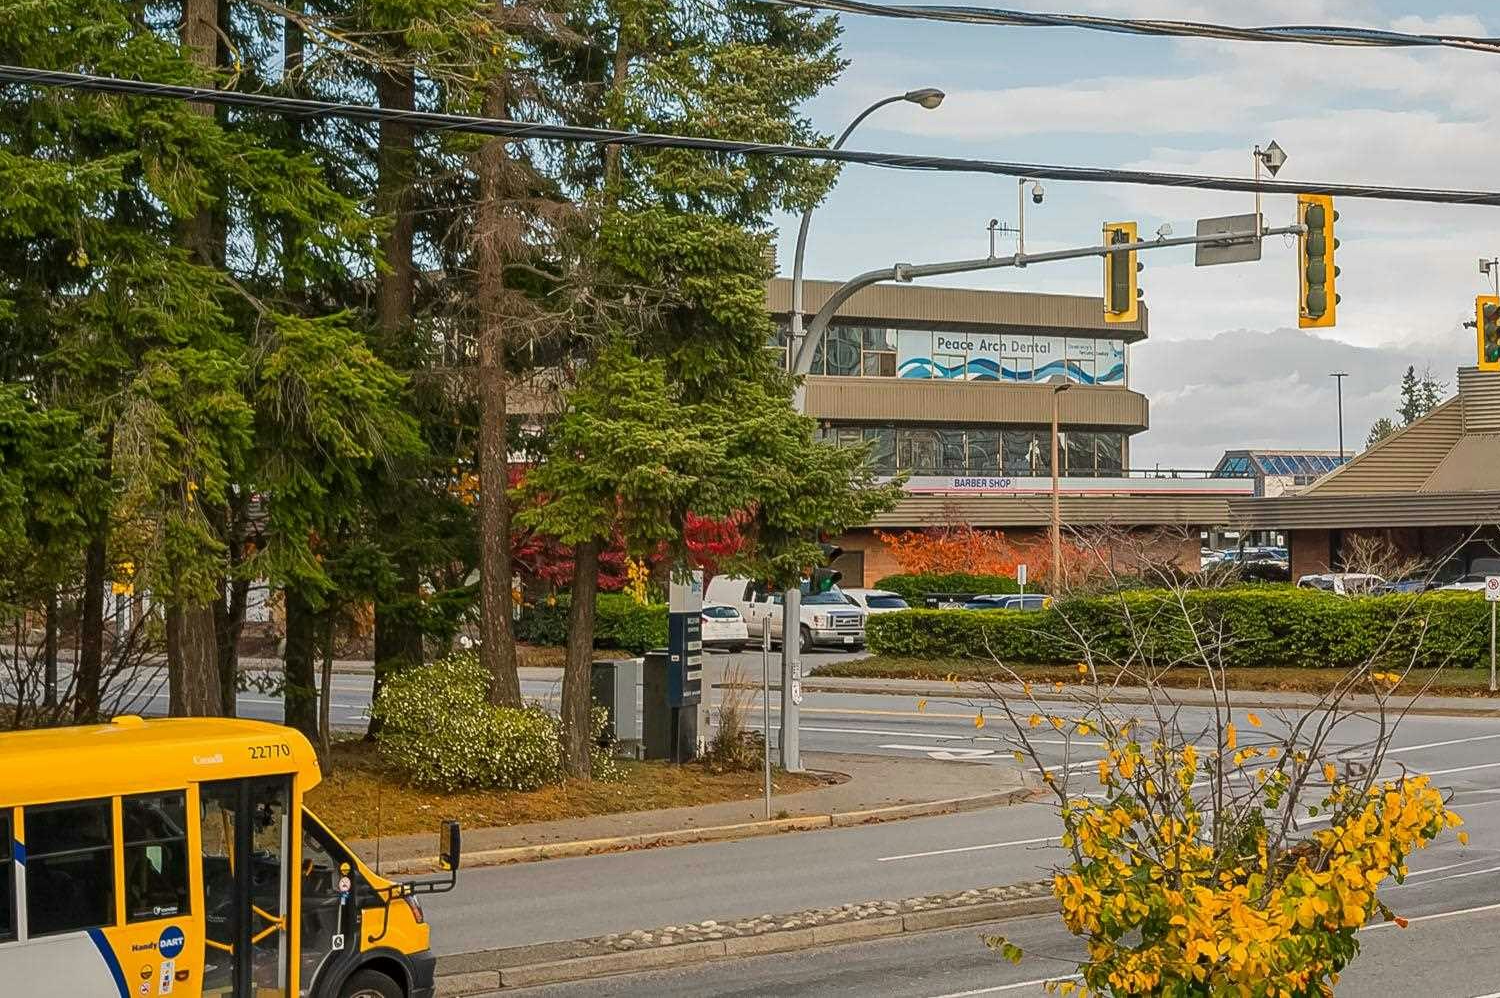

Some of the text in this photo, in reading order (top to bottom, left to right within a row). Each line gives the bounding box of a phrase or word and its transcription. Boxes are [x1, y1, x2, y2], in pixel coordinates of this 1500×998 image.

[937, 336, 974, 351] Peace
[979, 338, 1007, 352] Arch
[1011, 340, 1051, 354] Dental
[954, 478, 1011, 488] BARBER SHOP
[247, 744, 290, 760] 22770
